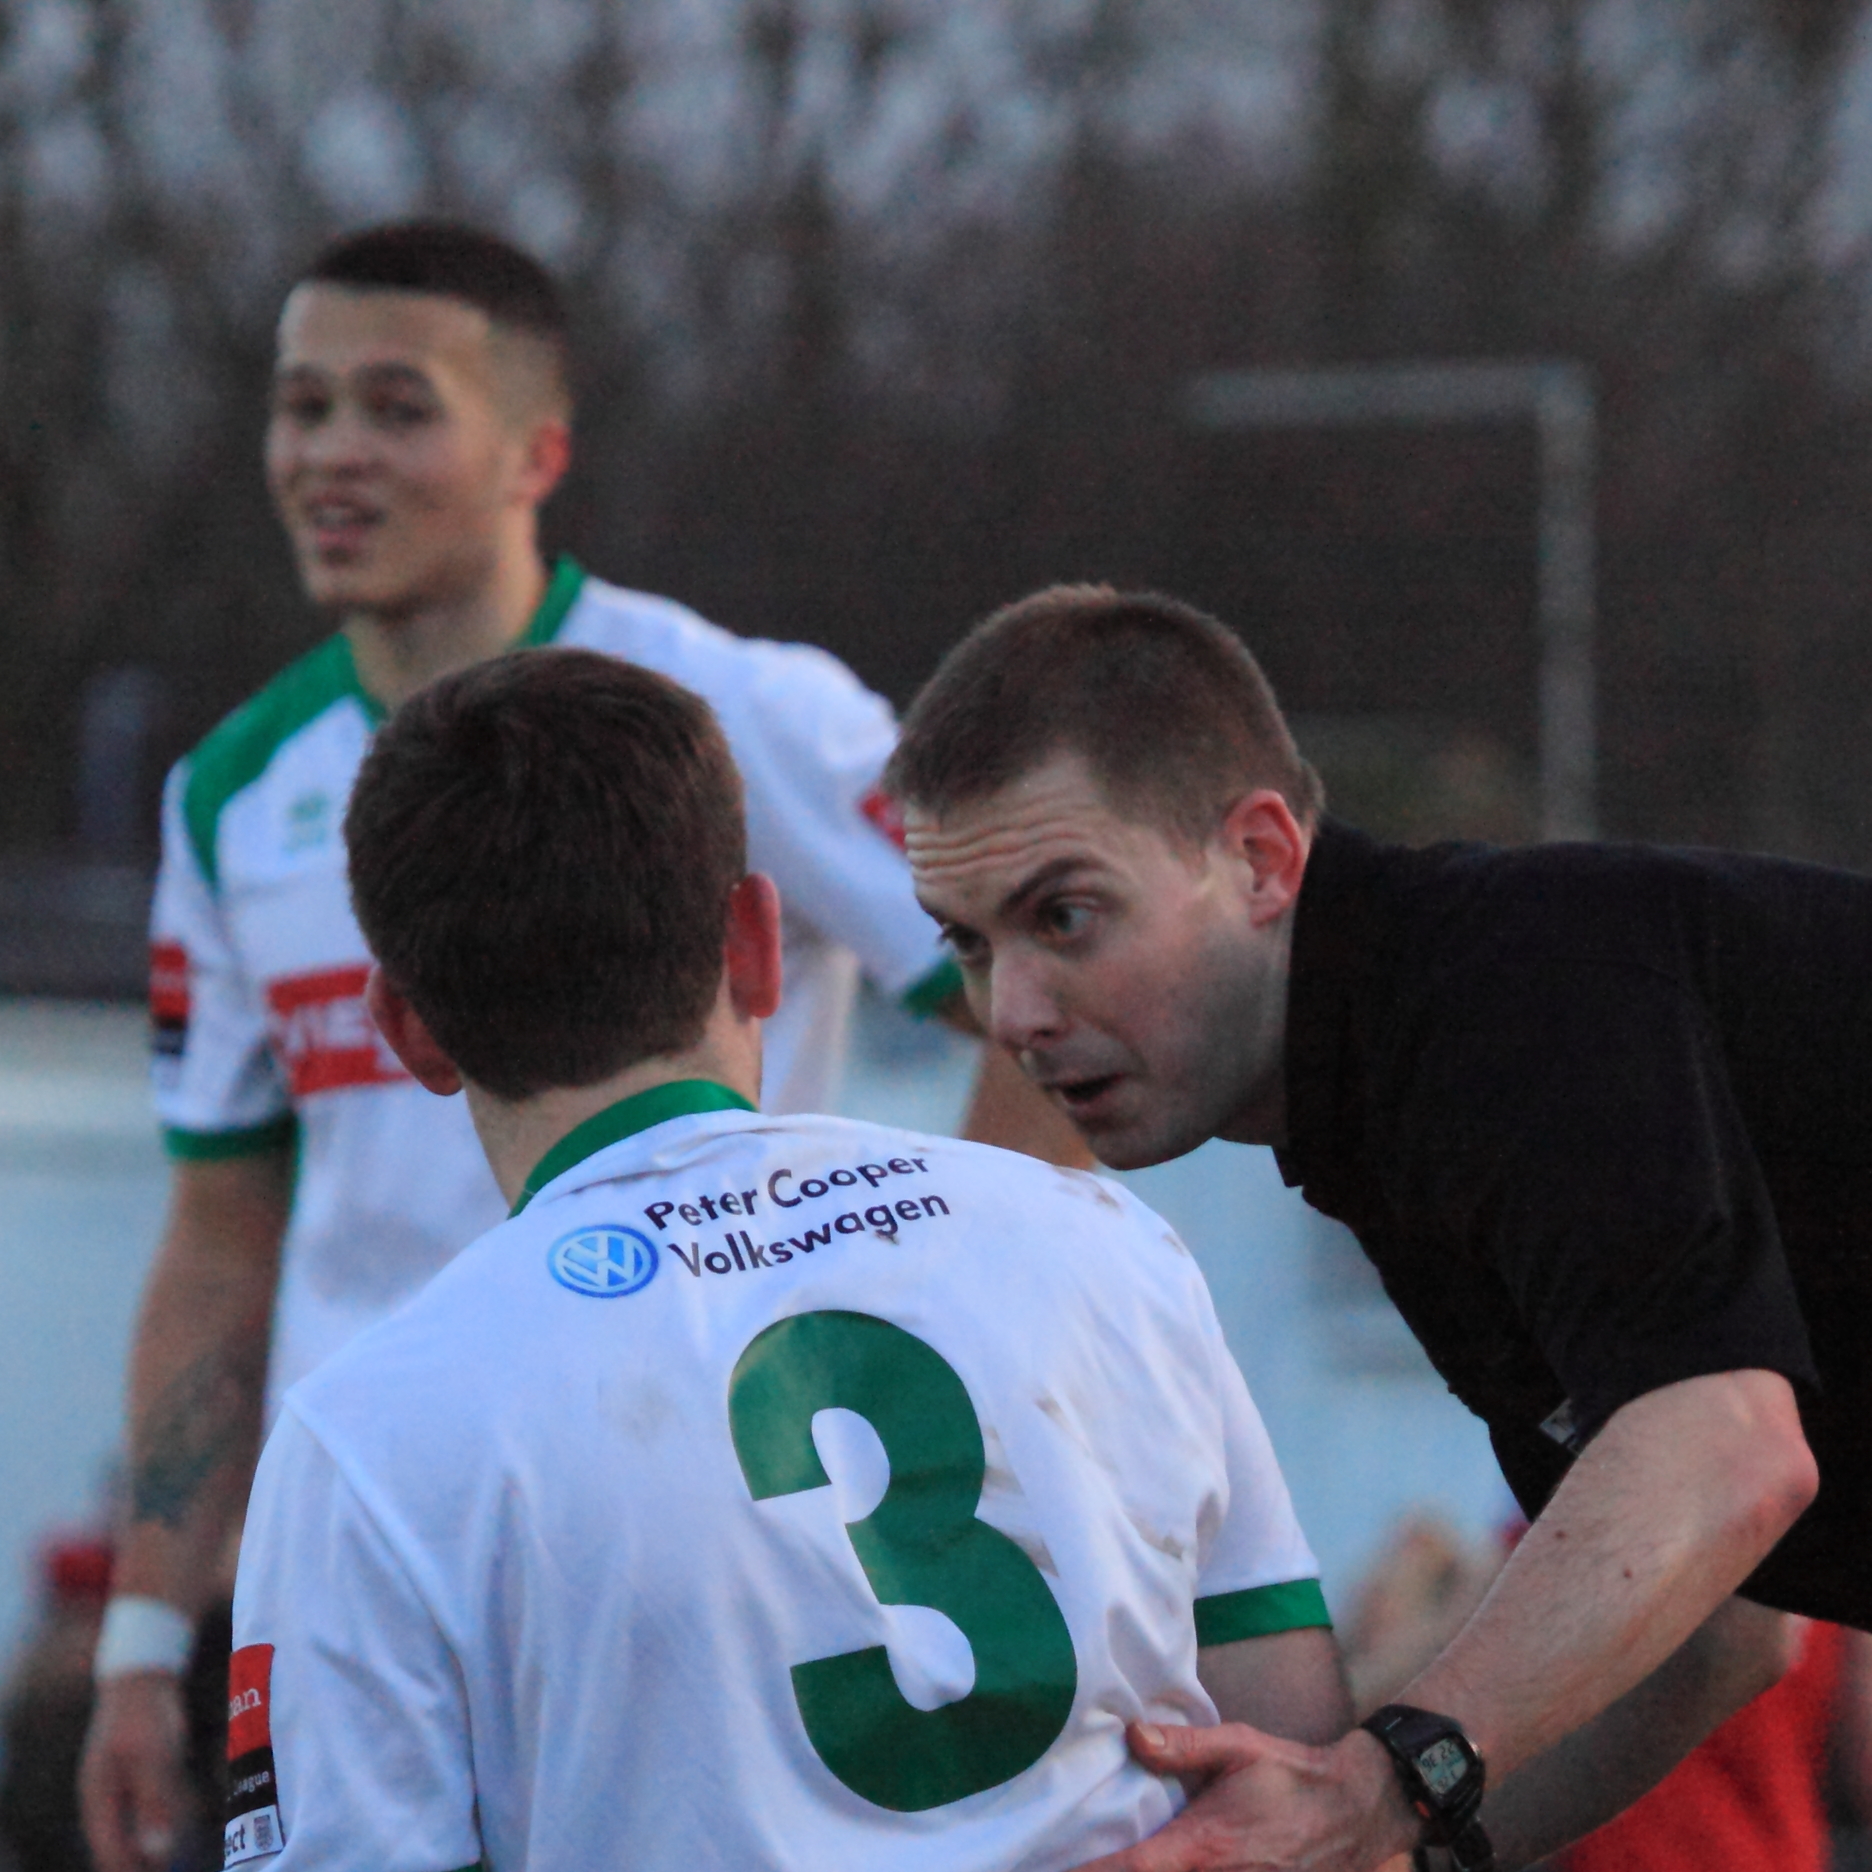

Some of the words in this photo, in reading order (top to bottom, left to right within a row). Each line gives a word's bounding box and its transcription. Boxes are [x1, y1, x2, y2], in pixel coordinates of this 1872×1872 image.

[644, 1188, 758, 1232] Peter
[766, 1157, 930, 1208] Cooper
[667, 1193, 951, 1277] Volkswagen
[728, 1309, 1077, 1812] 3
